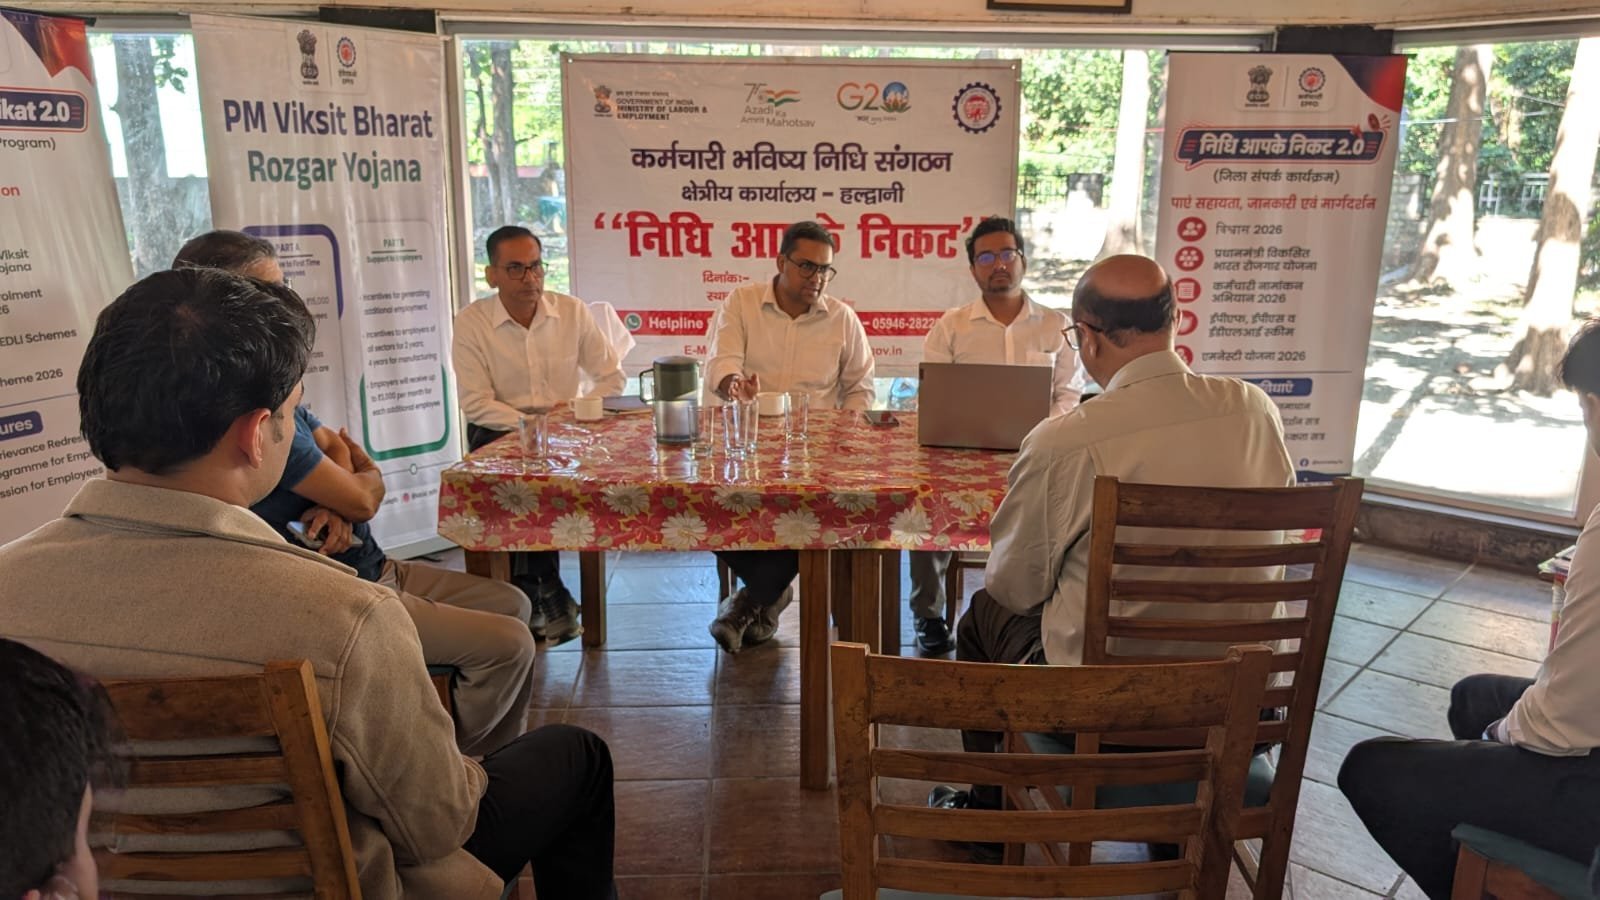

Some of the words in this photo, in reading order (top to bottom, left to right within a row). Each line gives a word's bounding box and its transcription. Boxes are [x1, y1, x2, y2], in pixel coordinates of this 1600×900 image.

[616, 98, 664, 106] GOVERNMENT
[665, 98, 674, 106] OF
[40, 101, 70, 122] 2.0
[617, 105, 653, 113] MINISTRY
[656, 105, 665, 113] OF
[744, 105, 774, 115] Azadi
[223, 99, 267, 134] PM
[273, 100, 348, 136] Viksit
[353, 105, 434, 138] Bharat
[617, 113, 669, 121] EMPLOYMENT
[766, 119, 815, 128] Mahotsav
[1199, 133, 1239, 156] निधि
[1240, 133, 1285, 156] आपके
[1288, 136, 1333, 156] निकट
[1336, 138, 1364, 155] 2.0
[631, 141, 725, 170] कर्मचारी
[733, 141, 807, 171] भविष्य
[814, 142, 868, 172] निधि
[875, 144, 953, 172] संगठन
[247, 150, 337, 190] Rozgar
[342, 150, 422, 190] Yojana
[1213, 169, 1247, 184] (जिला
[1251, 169, 1282, 183] संपर्क
[1285, 169, 1340, 184] कार्यक्रम)
[682, 180, 733, 202] क्षेत्रीय
[738, 180, 816, 203] कार्यालय
[840, 181, 904, 205] हल्द्वानी
[1195, 196, 1242, 210] सहायता,
[1247, 194, 1296, 209] जानकारी
[1300, 194, 1317, 209] एवं
[1320, 194, 1376, 209] मार्गदर्शन
[1253, 225, 1283, 235] 2026
[1214, 246, 1264, 259] प्रधानमंत्री
[1267, 246, 1311, 258] विकसित
[1213, 261, 1240, 271] भारत
[1243, 259, 1280, 271] रोजगार
[1283, 259, 1317, 271] योजना
[1213, 279, 1256, 291] कर्मचारी
[1258, 280, 1304, 291] नामांकन
[1212, 291, 1255, 304] अभियान
[1257, 294, 1286, 303] 2026
[649, 317, 704, 332] Helpline
[872, 317, 940, 330] 05946-2822
[25, 329, 77, 344] Schemes
[1264, 325, 1294, 337] स्कीम
[684, 345, 708, 355] E-M
[1245, 349, 1275, 361] योजना
[1277, 351, 1306, 361] 2026
[35, 368, 64, 381] 2026
[50, 455, 65, 467] for
[67, 452, 92, 465] Emp
[30, 479, 45, 491] for
[47, 466, 104, 487] Employees
